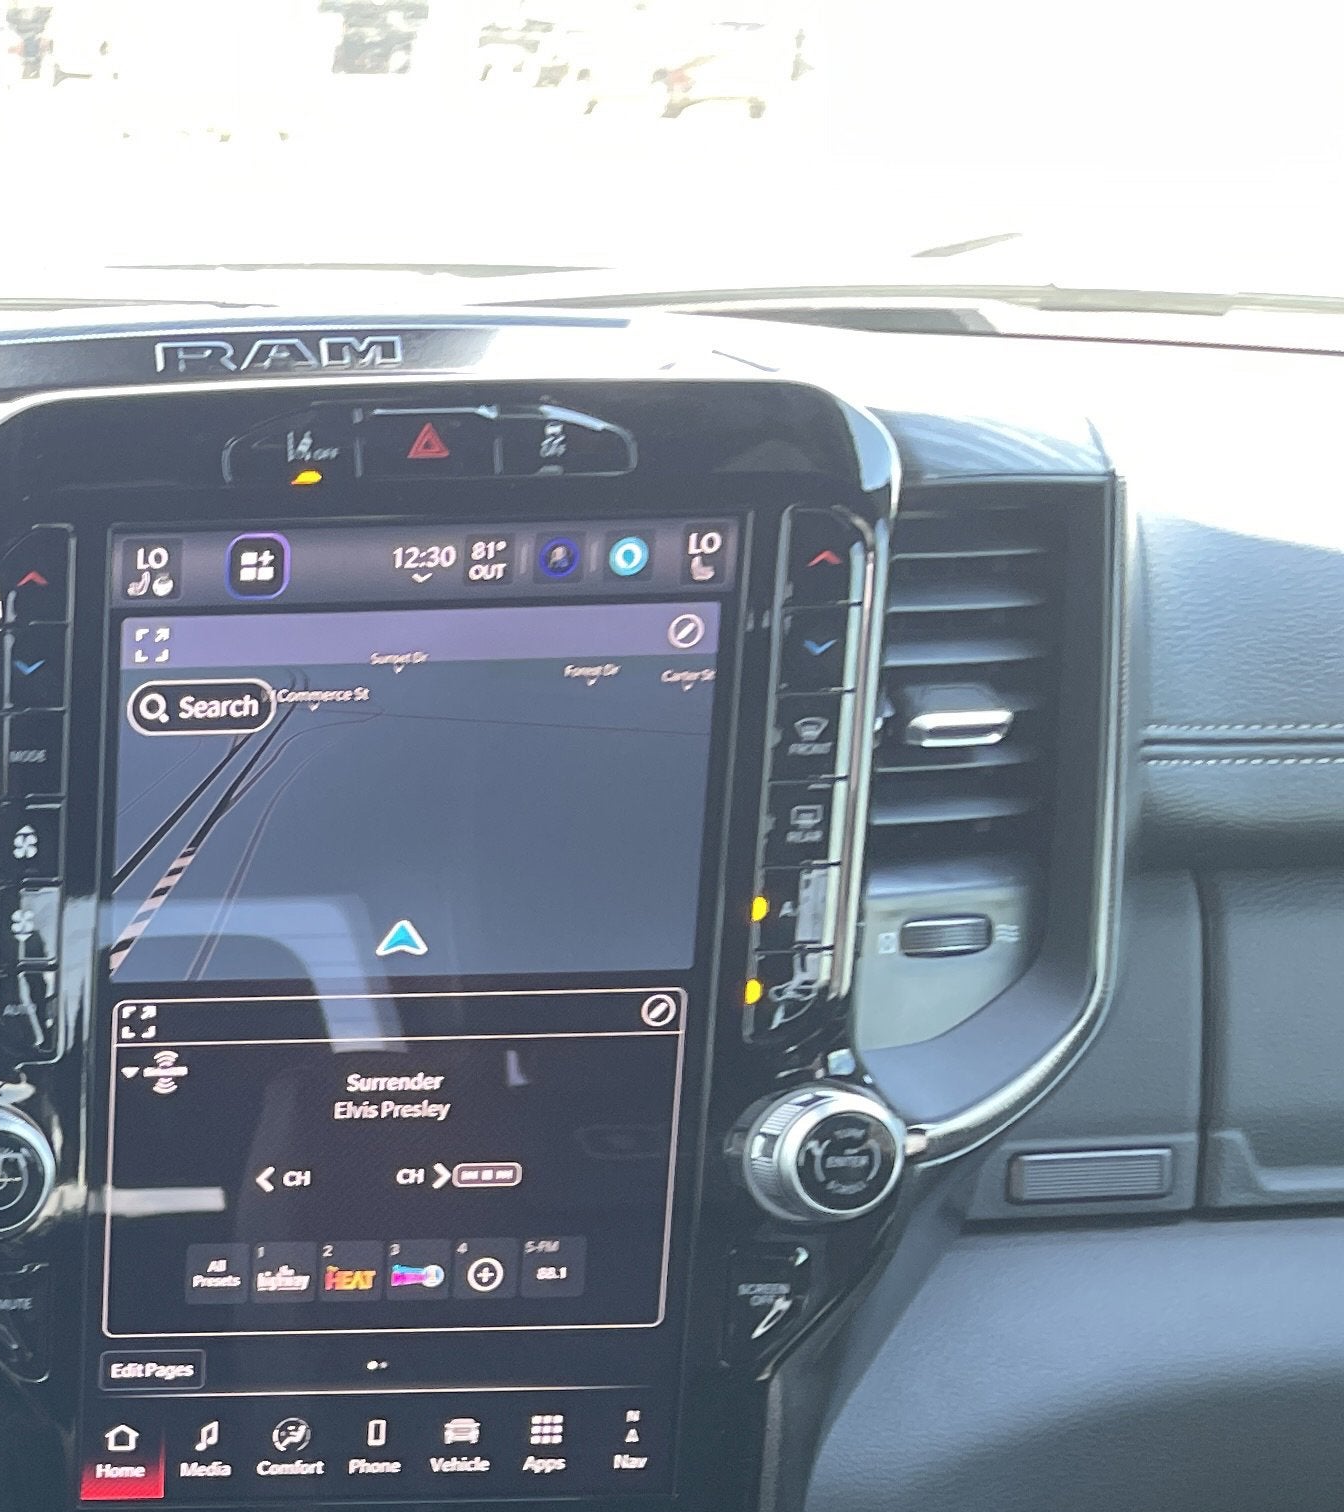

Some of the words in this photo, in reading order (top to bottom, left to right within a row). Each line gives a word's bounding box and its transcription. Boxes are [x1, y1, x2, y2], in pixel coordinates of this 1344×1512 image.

[155, 335, 403, 372] RAM
[688, 531, 722, 555] LO
[137, 547, 168, 570] LO
[393, 545, 457, 569] 12:30
[468, 563, 507, 581] OUT
[276, 686, 353, 703] Commerce
[178, 694, 260, 720] Search
[345, 1071, 445, 1092] Surrender
[333, 1101, 379, 1121] Elvis
[380, 1099, 452, 1122] Presley
[282, 1169, 311, 1186] CH
[396, 1168, 425, 1185] CH
[322, 1245, 334, 1257] 2
[206, 1259, 227, 1273] All
[192, 1274, 242, 1288] Presets
[324, 1270, 377, 1292] HEAT
[110, 1363, 144, 1379] Edit
[144, 1361, 196, 1381] Pages
[95, 1463, 146, 1479] Home
[179, 1461, 232, 1478] Media
[256, 1459, 326, 1477] Comfort
[348, 1458, 402, 1475] Phone
[428, 1456, 491, 1473] Vehicle
[522, 1455, 567, 1474] Apps
[613, 1454, 648, 1470] Nav
